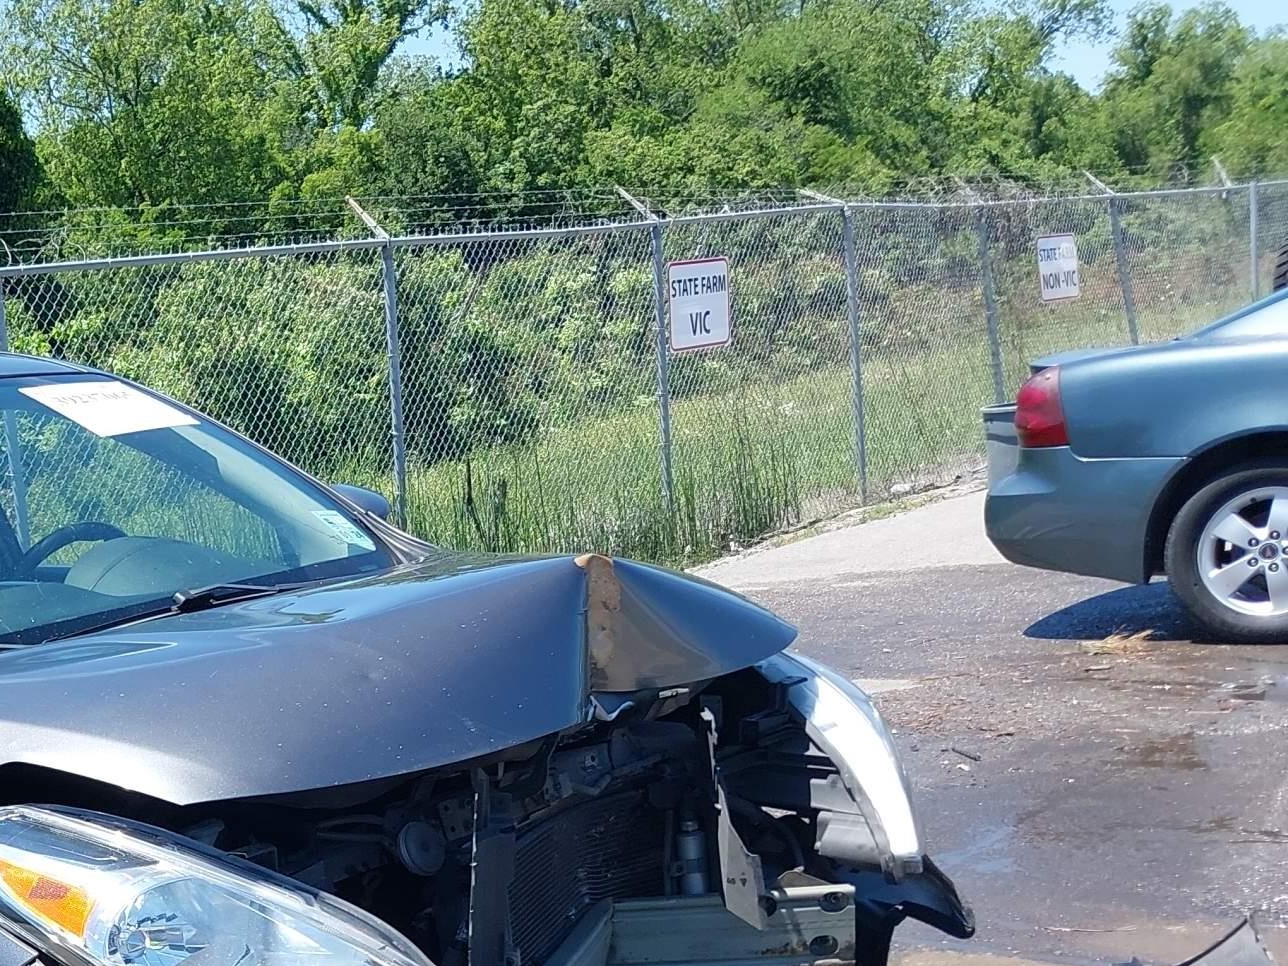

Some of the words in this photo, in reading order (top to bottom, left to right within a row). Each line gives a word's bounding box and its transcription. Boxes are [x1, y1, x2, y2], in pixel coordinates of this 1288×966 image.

[1039, 247, 1057, 262] STATE
[671, 277, 699, 298] STATE
[701, 274, 726, 295] FARM
[689, 310, 711, 336] VIC
